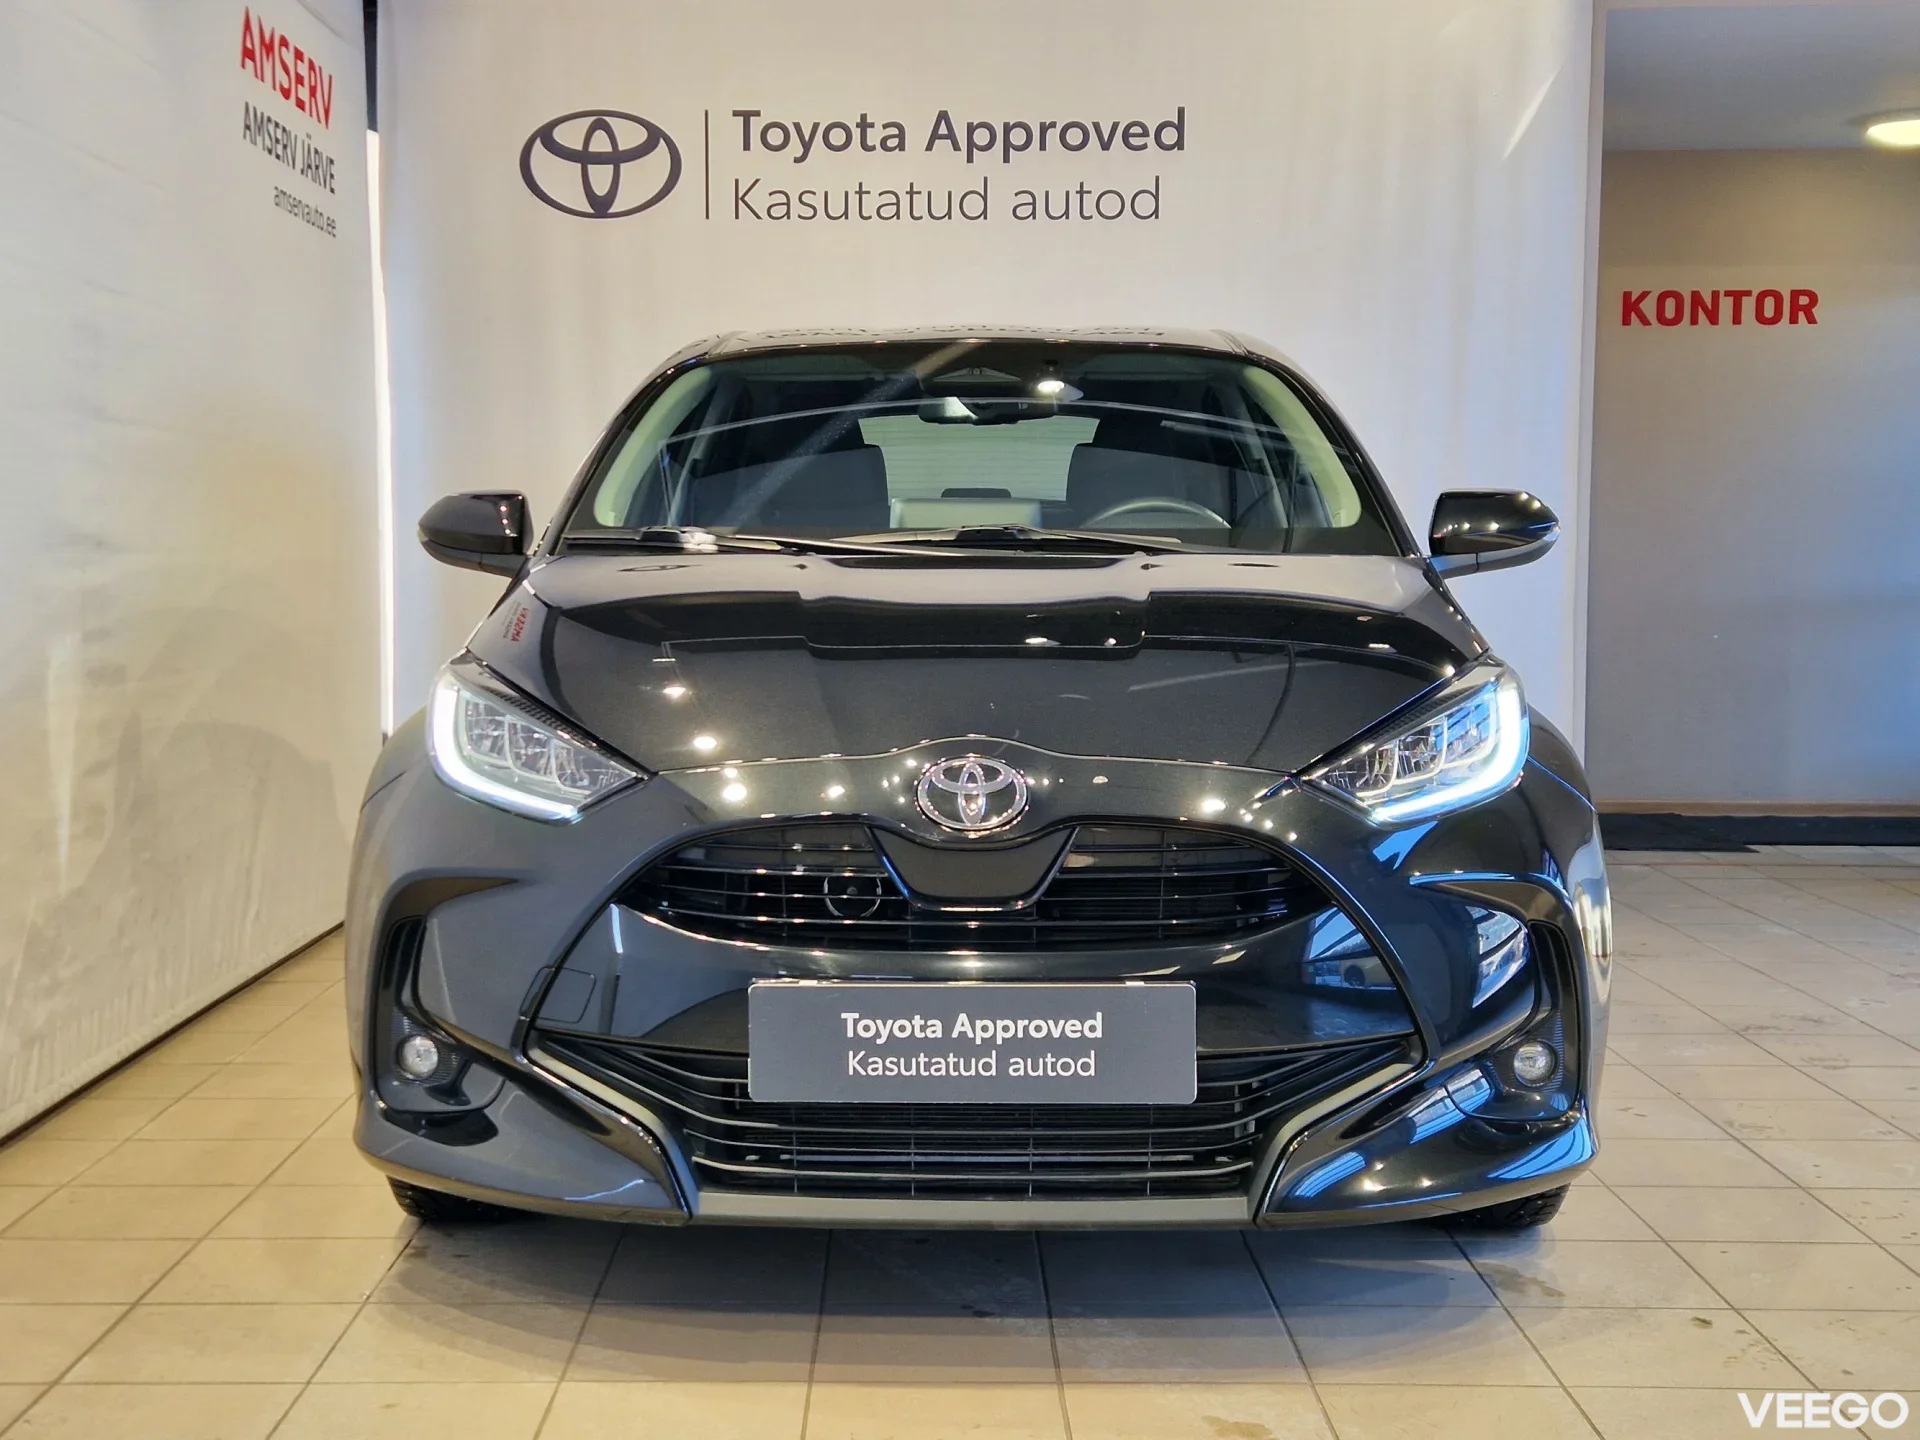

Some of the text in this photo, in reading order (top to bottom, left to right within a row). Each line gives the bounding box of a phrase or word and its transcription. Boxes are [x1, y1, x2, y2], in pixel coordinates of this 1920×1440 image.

[241, 6, 333, 129] AMSERV
[243, 101, 336, 194] AMSERV JÄRVE
[732, 107, 1186, 163] Toyota Approved
[273, 186, 337, 238] amservauto.ee
[734, 176, 1160, 220] Kasutatud autod
[1621, 289, 1820, 327] KONTOR
[841, 1012, 1103, 1044] Toyota Approved
[848, 1050, 1095, 1077] Kasutatud autod
